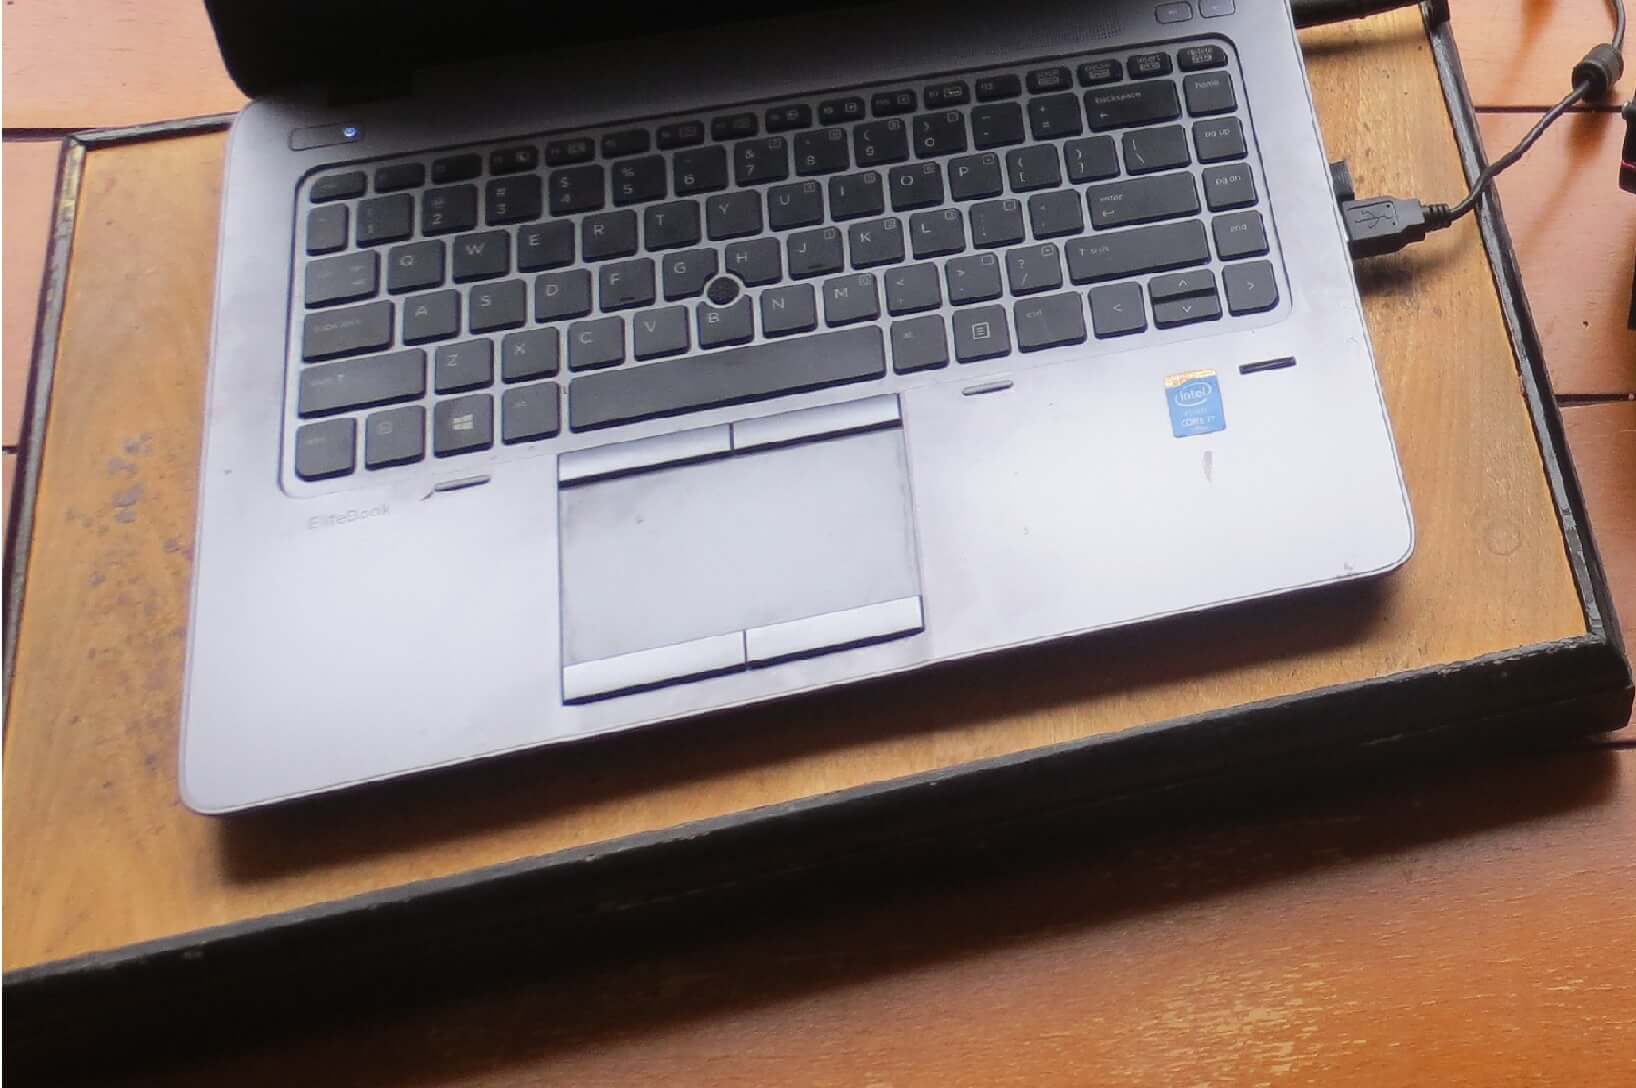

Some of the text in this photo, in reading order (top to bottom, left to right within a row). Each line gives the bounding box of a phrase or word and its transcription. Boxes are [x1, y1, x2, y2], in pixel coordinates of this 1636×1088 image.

[958, 166, 969, 177] P
[779, 193, 791, 206] U
[718, 202, 730, 215] Y
[655, 214, 666, 227] T
[593, 223, 605, 236] R
[920, 222, 932, 234] L
[529, 234, 541, 246] E
[859, 231, 872, 243] K
[465, 242, 485, 256] W
[798, 241, 807, 253] J
[400, 255, 414, 267] Q
[735, 251, 748, 263] H
[673, 261, 687, 274] G
[609, 272, 621, 286] F
[545, 284, 560, 297] D
[833, 287, 848, 298] M
[479, 295, 492, 307] S
[771, 297, 785, 310] N
[415, 305, 429, 317] A
[707, 312, 720, 324] B
[643, 320, 657, 333] V
[579, 330, 593, 345] C
[513, 342, 526, 355] X
[447, 353, 459, 367] Z
